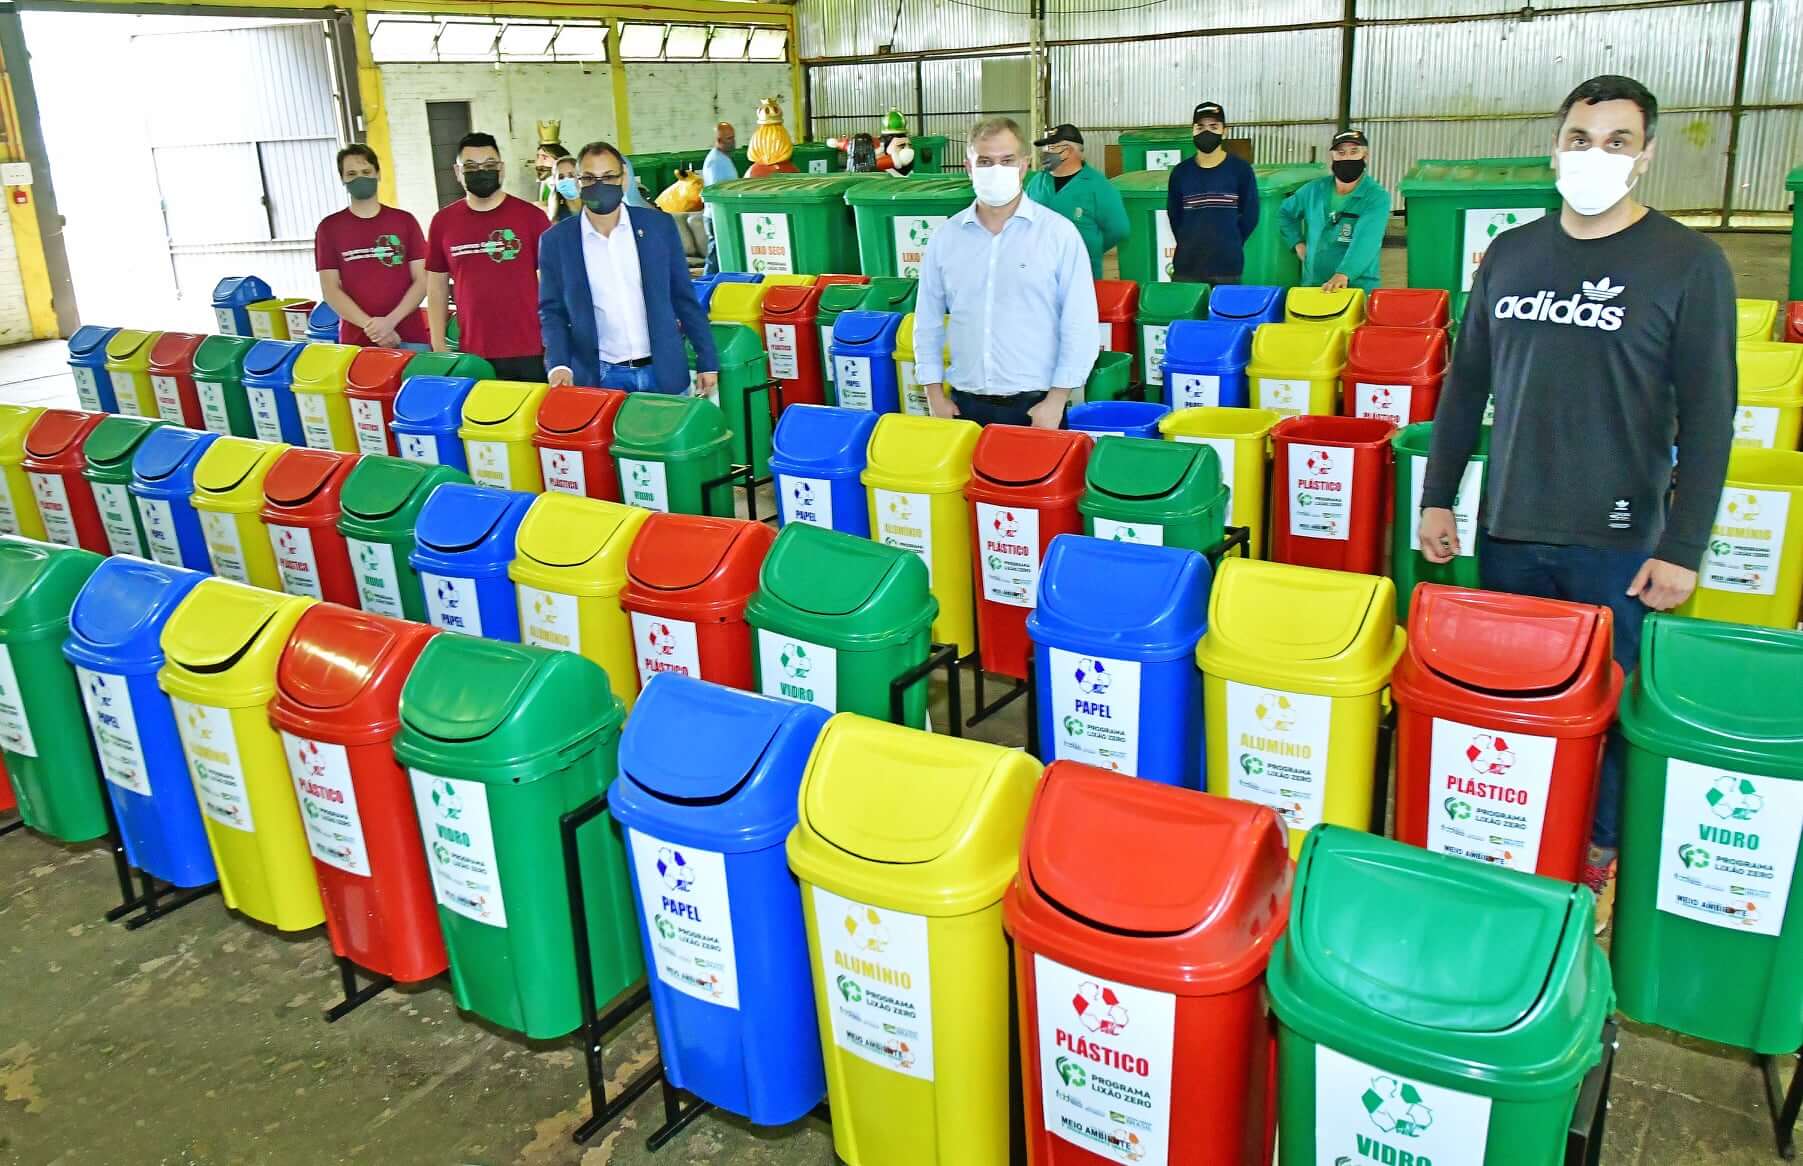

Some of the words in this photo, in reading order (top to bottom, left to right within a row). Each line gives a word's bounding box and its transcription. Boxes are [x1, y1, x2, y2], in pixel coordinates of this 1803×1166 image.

[1494, 290, 1626, 331] adidas
[795, 510, 817, 521] PAPEL
[987, 541, 1029, 556] PLÁSTICO
[441, 613, 465, 627] PAPEL
[780, 682, 814, 702] VIDRO
[1075, 699, 1112, 719] PAPEL
[1240, 733, 1312, 759] ALUMÍNIO
[1447, 775, 1528, 805] PLÁSTICO
[1699, 823, 1760, 851] VIDRO
[1715, 856, 1773, 871] PROGRAMA
[662, 896, 702, 922] PAPEL
[834, 949, 912, 990] ALUMÍNIO
[865, 990, 915, 1010] PROGRAMA
[1056, 1028, 1149, 1077] PLÁSTICO
[1091, 1074, 1151, 1100] PROGRAMA
[1091, 1085, 1122, 1100] LIXÃO
[1123, 1094, 1152, 1109] ZERO
[1061, 1115, 1083, 1132] MEIO
